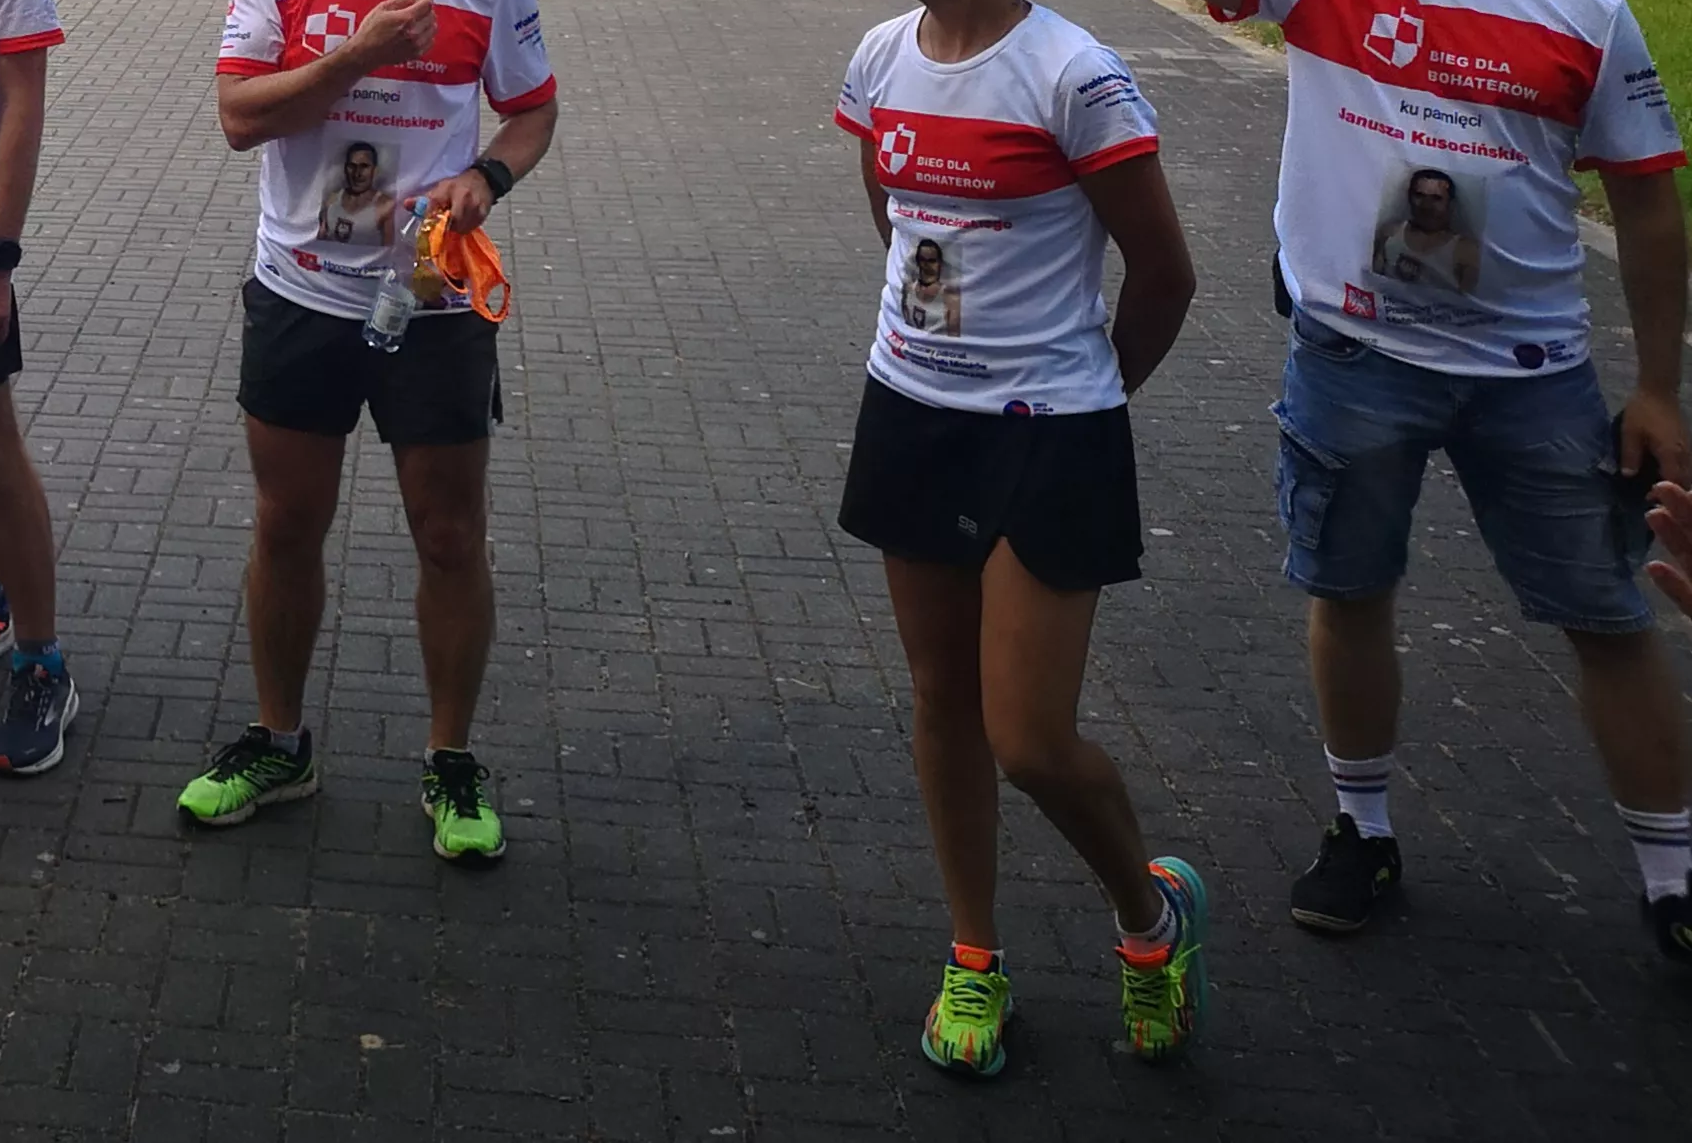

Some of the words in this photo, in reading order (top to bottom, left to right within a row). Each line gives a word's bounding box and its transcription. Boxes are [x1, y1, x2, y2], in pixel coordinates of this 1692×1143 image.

[1429, 50, 1469, 67] BIEG
[1475, 57, 1511, 74] DLA
[1427, 69, 1539, 101] BOHATERÓW
[352, 89, 401, 104] pamięci
[345, 110, 445, 131] Kusocińskiego
[1338, 107, 1405, 141] Janusza
[1399, 100, 1419, 116] ku
[1423, 106, 1482, 129] pamięci
[916, 155, 944, 169] BIEG
[946, 159, 971, 173] DLA
[915, 171, 996, 190] BOHATERÓW
